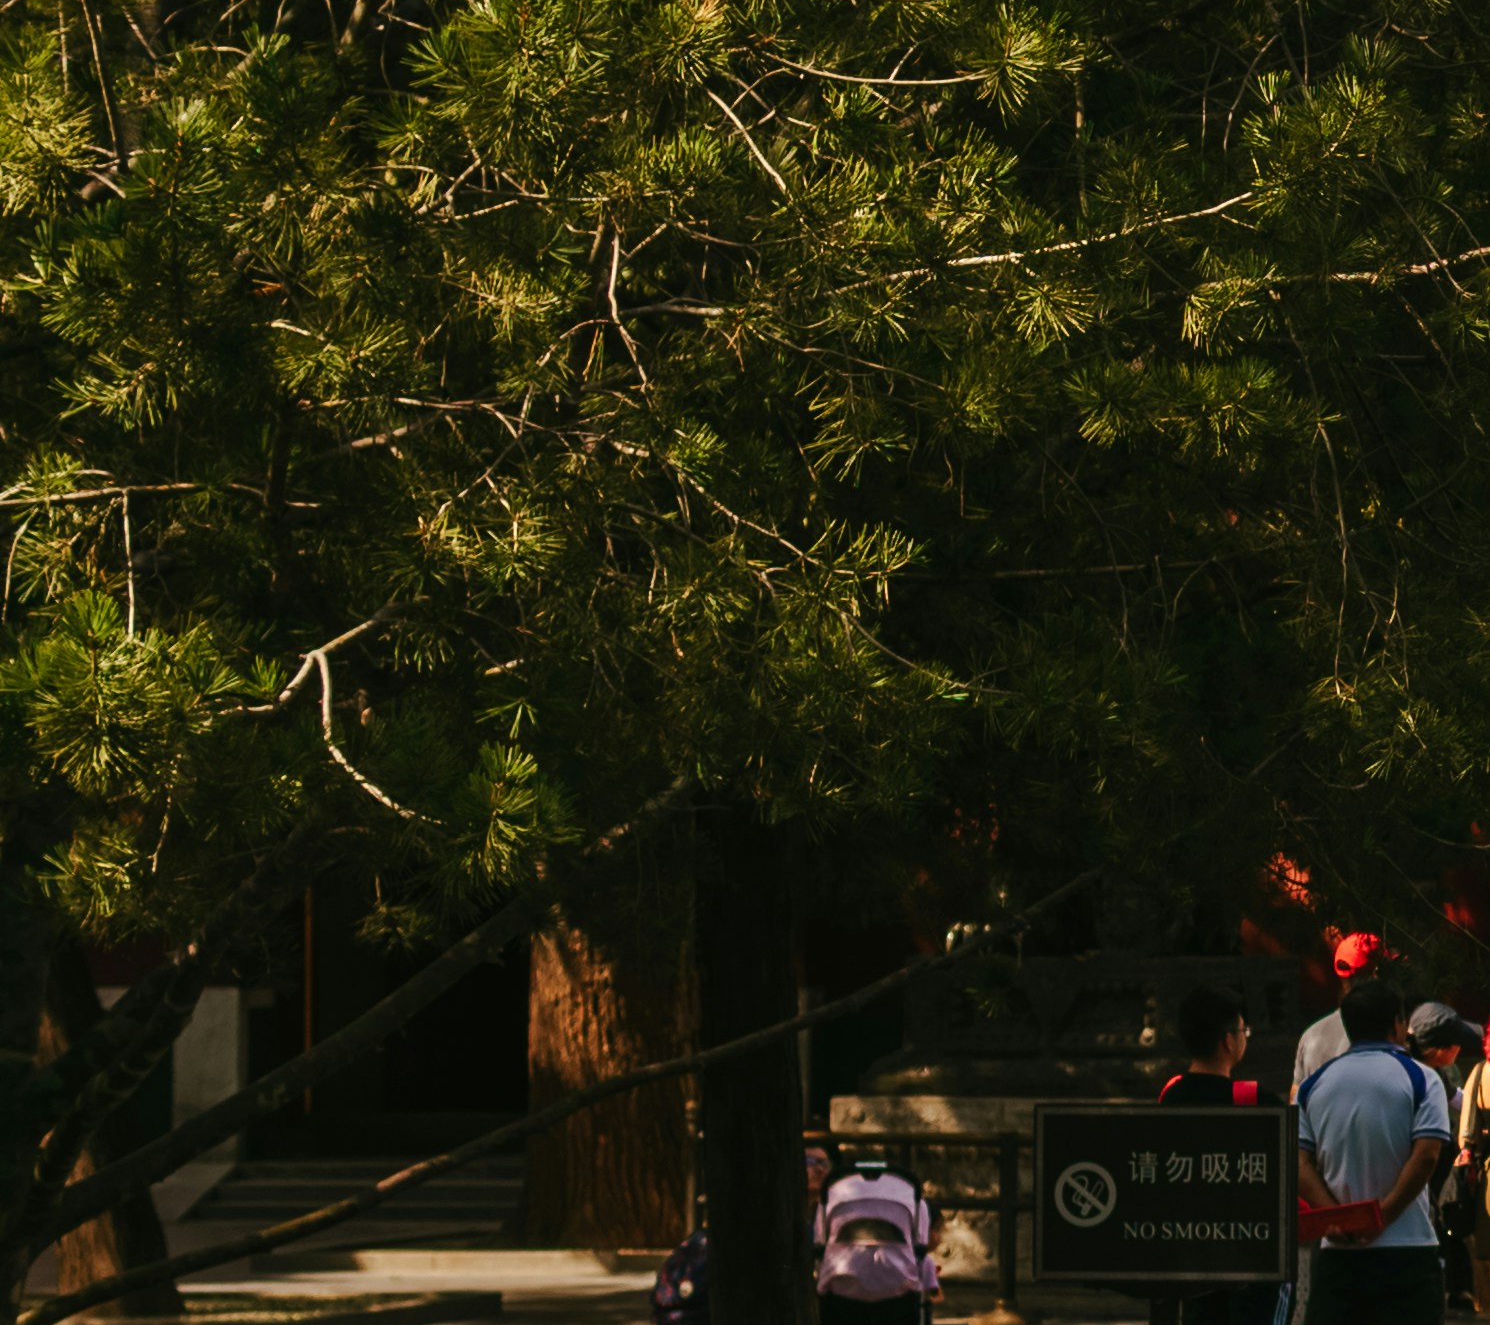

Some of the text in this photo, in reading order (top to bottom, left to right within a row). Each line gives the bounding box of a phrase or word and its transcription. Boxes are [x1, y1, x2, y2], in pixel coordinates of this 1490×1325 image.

[1128, 1151, 1267, 1185] 请勿吸烟
[1123, 1221, 1270, 1241] NO SMOKING
